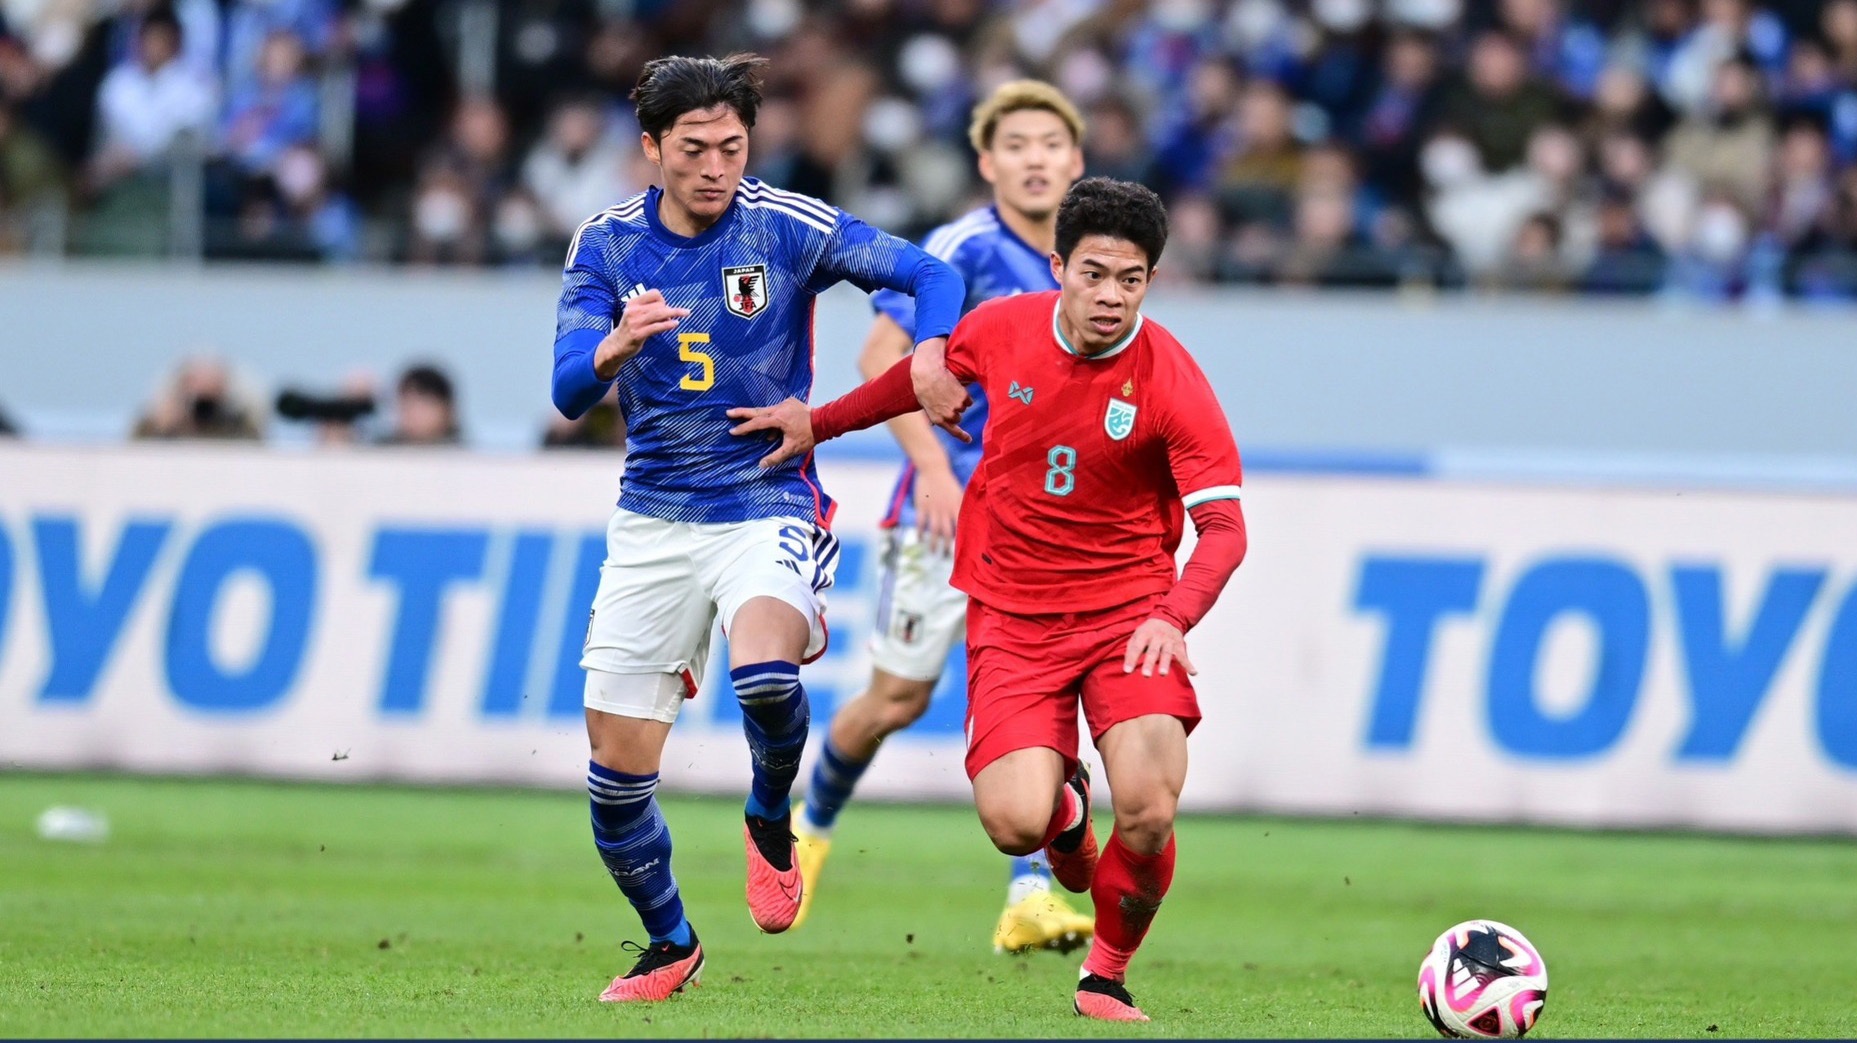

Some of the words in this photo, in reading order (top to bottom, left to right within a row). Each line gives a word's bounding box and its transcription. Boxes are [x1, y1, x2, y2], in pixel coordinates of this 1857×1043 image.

[739, 301, 757, 311] JFA
[678, 333, 714, 391] 5
[1044, 445, 1077, 496] 8
[778, 525, 809, 562] 5
[0, 510, 324, 714] YO
[1350, 551, 1857, 775] TOY
